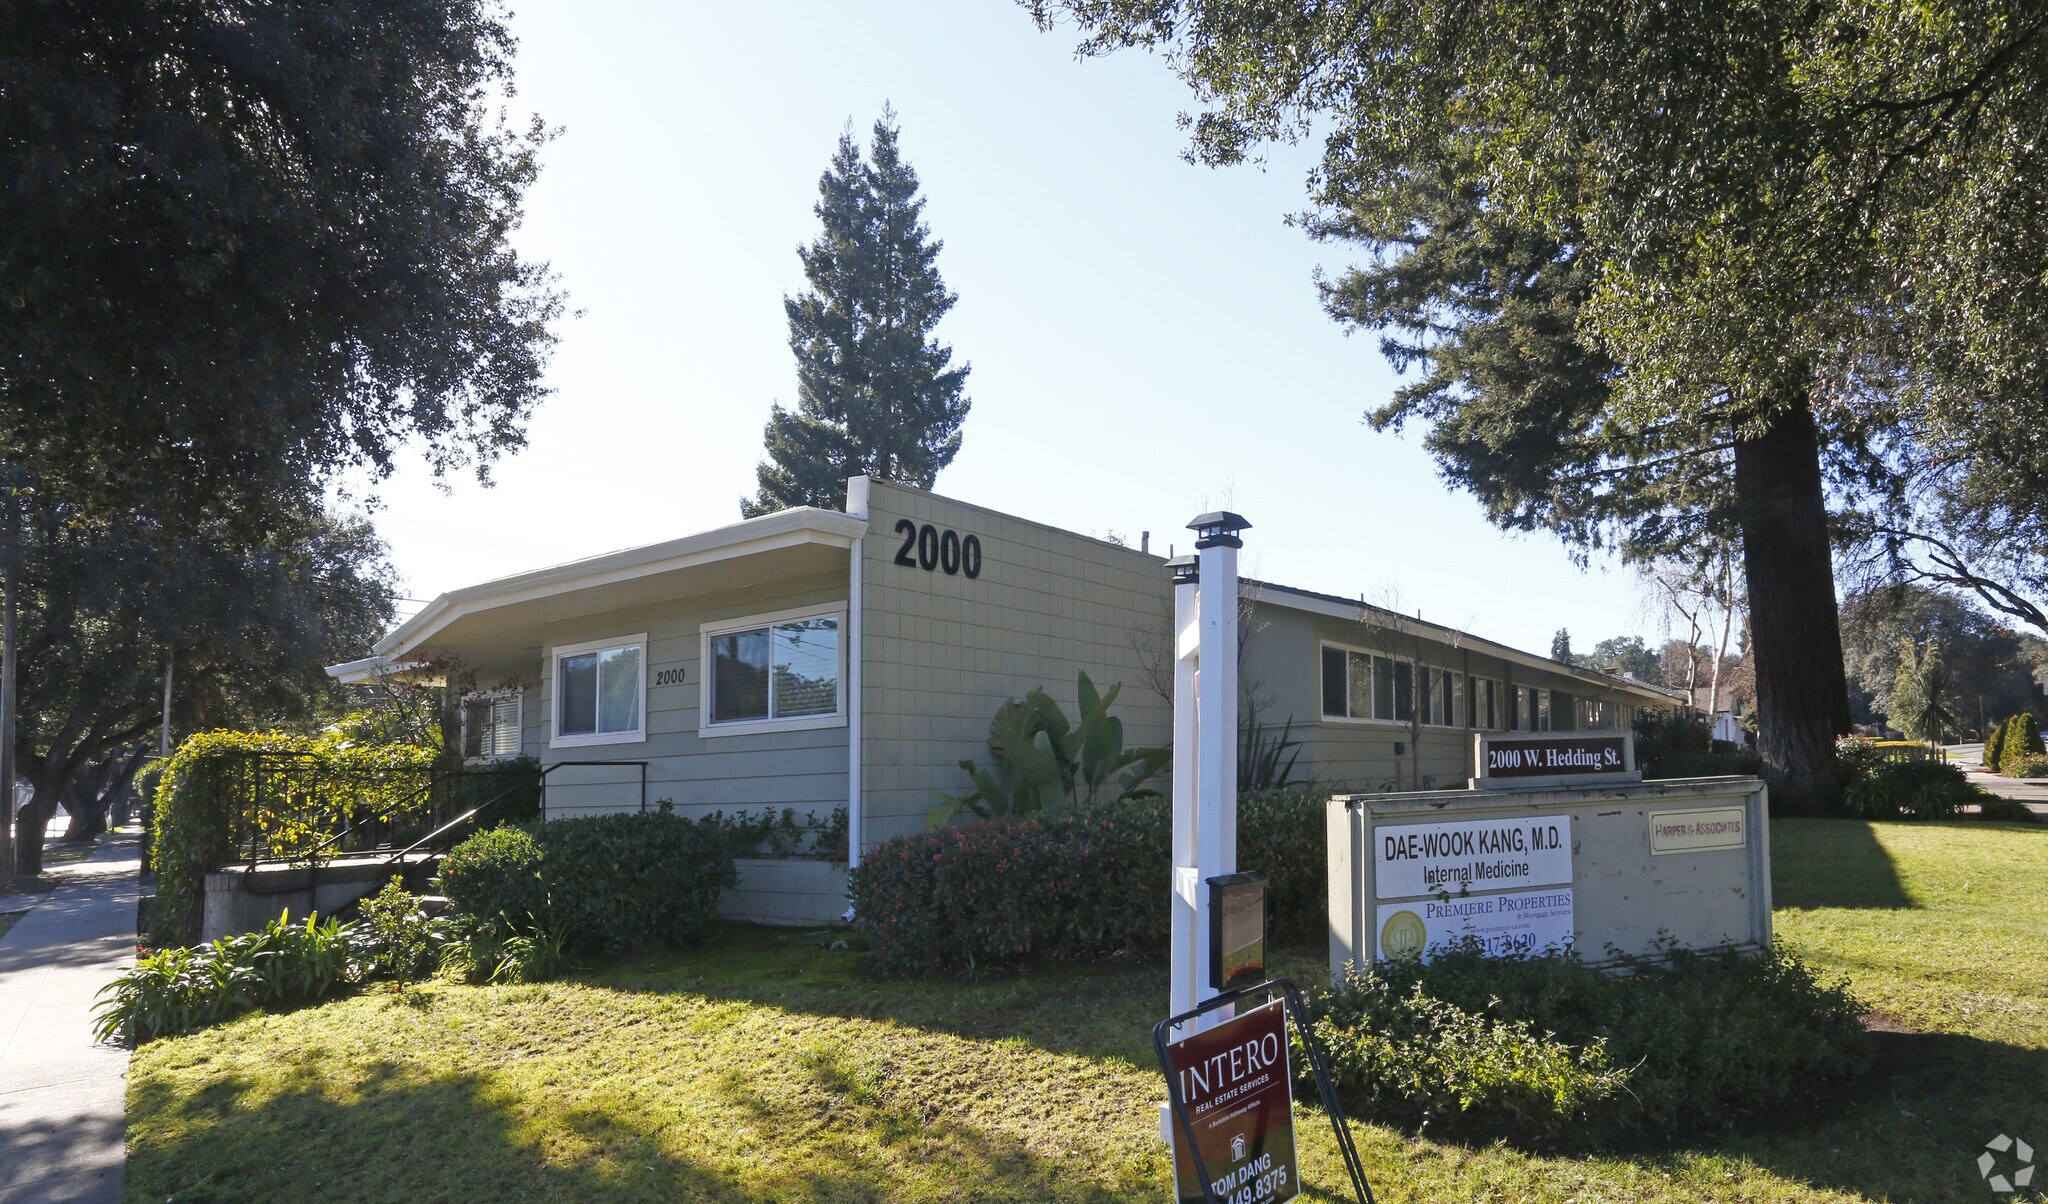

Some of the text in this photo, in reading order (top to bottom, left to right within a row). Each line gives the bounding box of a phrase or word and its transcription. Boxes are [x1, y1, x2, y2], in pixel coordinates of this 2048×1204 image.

[894, 518, 982, 579] 2000
[656, 667, 685, 685] 2000
[1489, 747, 1621, 770] 2000 W. Hedding St.
[1385, 826, 1562, 861] DAE-WOOK KANG, M.D.
[1424, 860, 1530, 884] Internal Medicine
[1426, 894, 1571, 919] PREMIERE PROPERTIES
[1523, 911, 1549, 920] Mortgage
[1179, 1032, 1278, 1104] INTERO
[1195, 1074, 1269, 1115] REAL ESTATE SERVICES
[1211, 1153, 1272, 1196] TOM DANG
